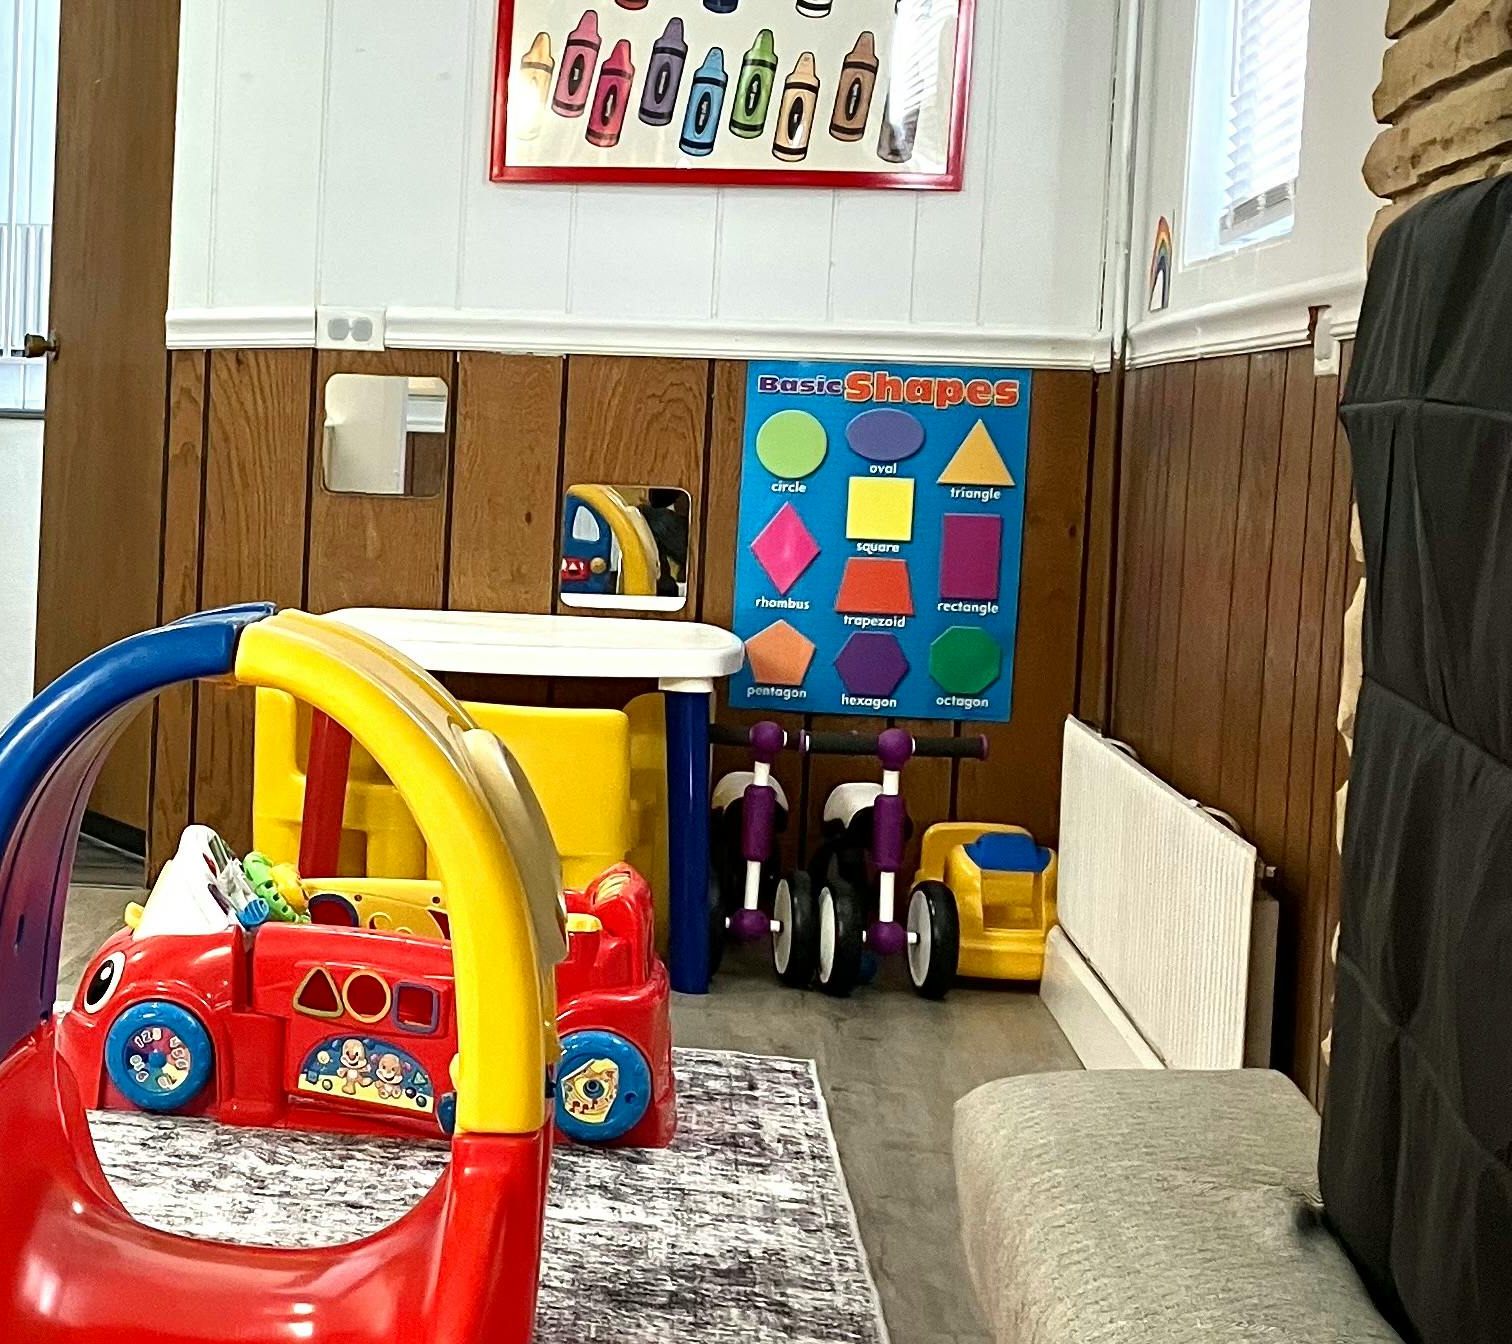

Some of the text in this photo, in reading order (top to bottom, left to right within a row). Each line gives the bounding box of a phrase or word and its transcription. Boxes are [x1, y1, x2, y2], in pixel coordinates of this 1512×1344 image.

[757, 370, 1020, 408] Basic Shapes
[868, 462, 897, 475] oval
[771, 480, 807, 494] circle
[949, 487, 1001, 501] triangle
[856, 541, 900, 555] square
[754, 597, 810, 610] rhombus
[937, 601, 999, 616] rectangle
[843, 614, 906, 628] trapezoid
[746, 686, 807, 700] pentagon
[841, 694, 897, 709] hexagon
[936, 695, 989, 708] octagon
[140, 1030, 152, 1044] 2
